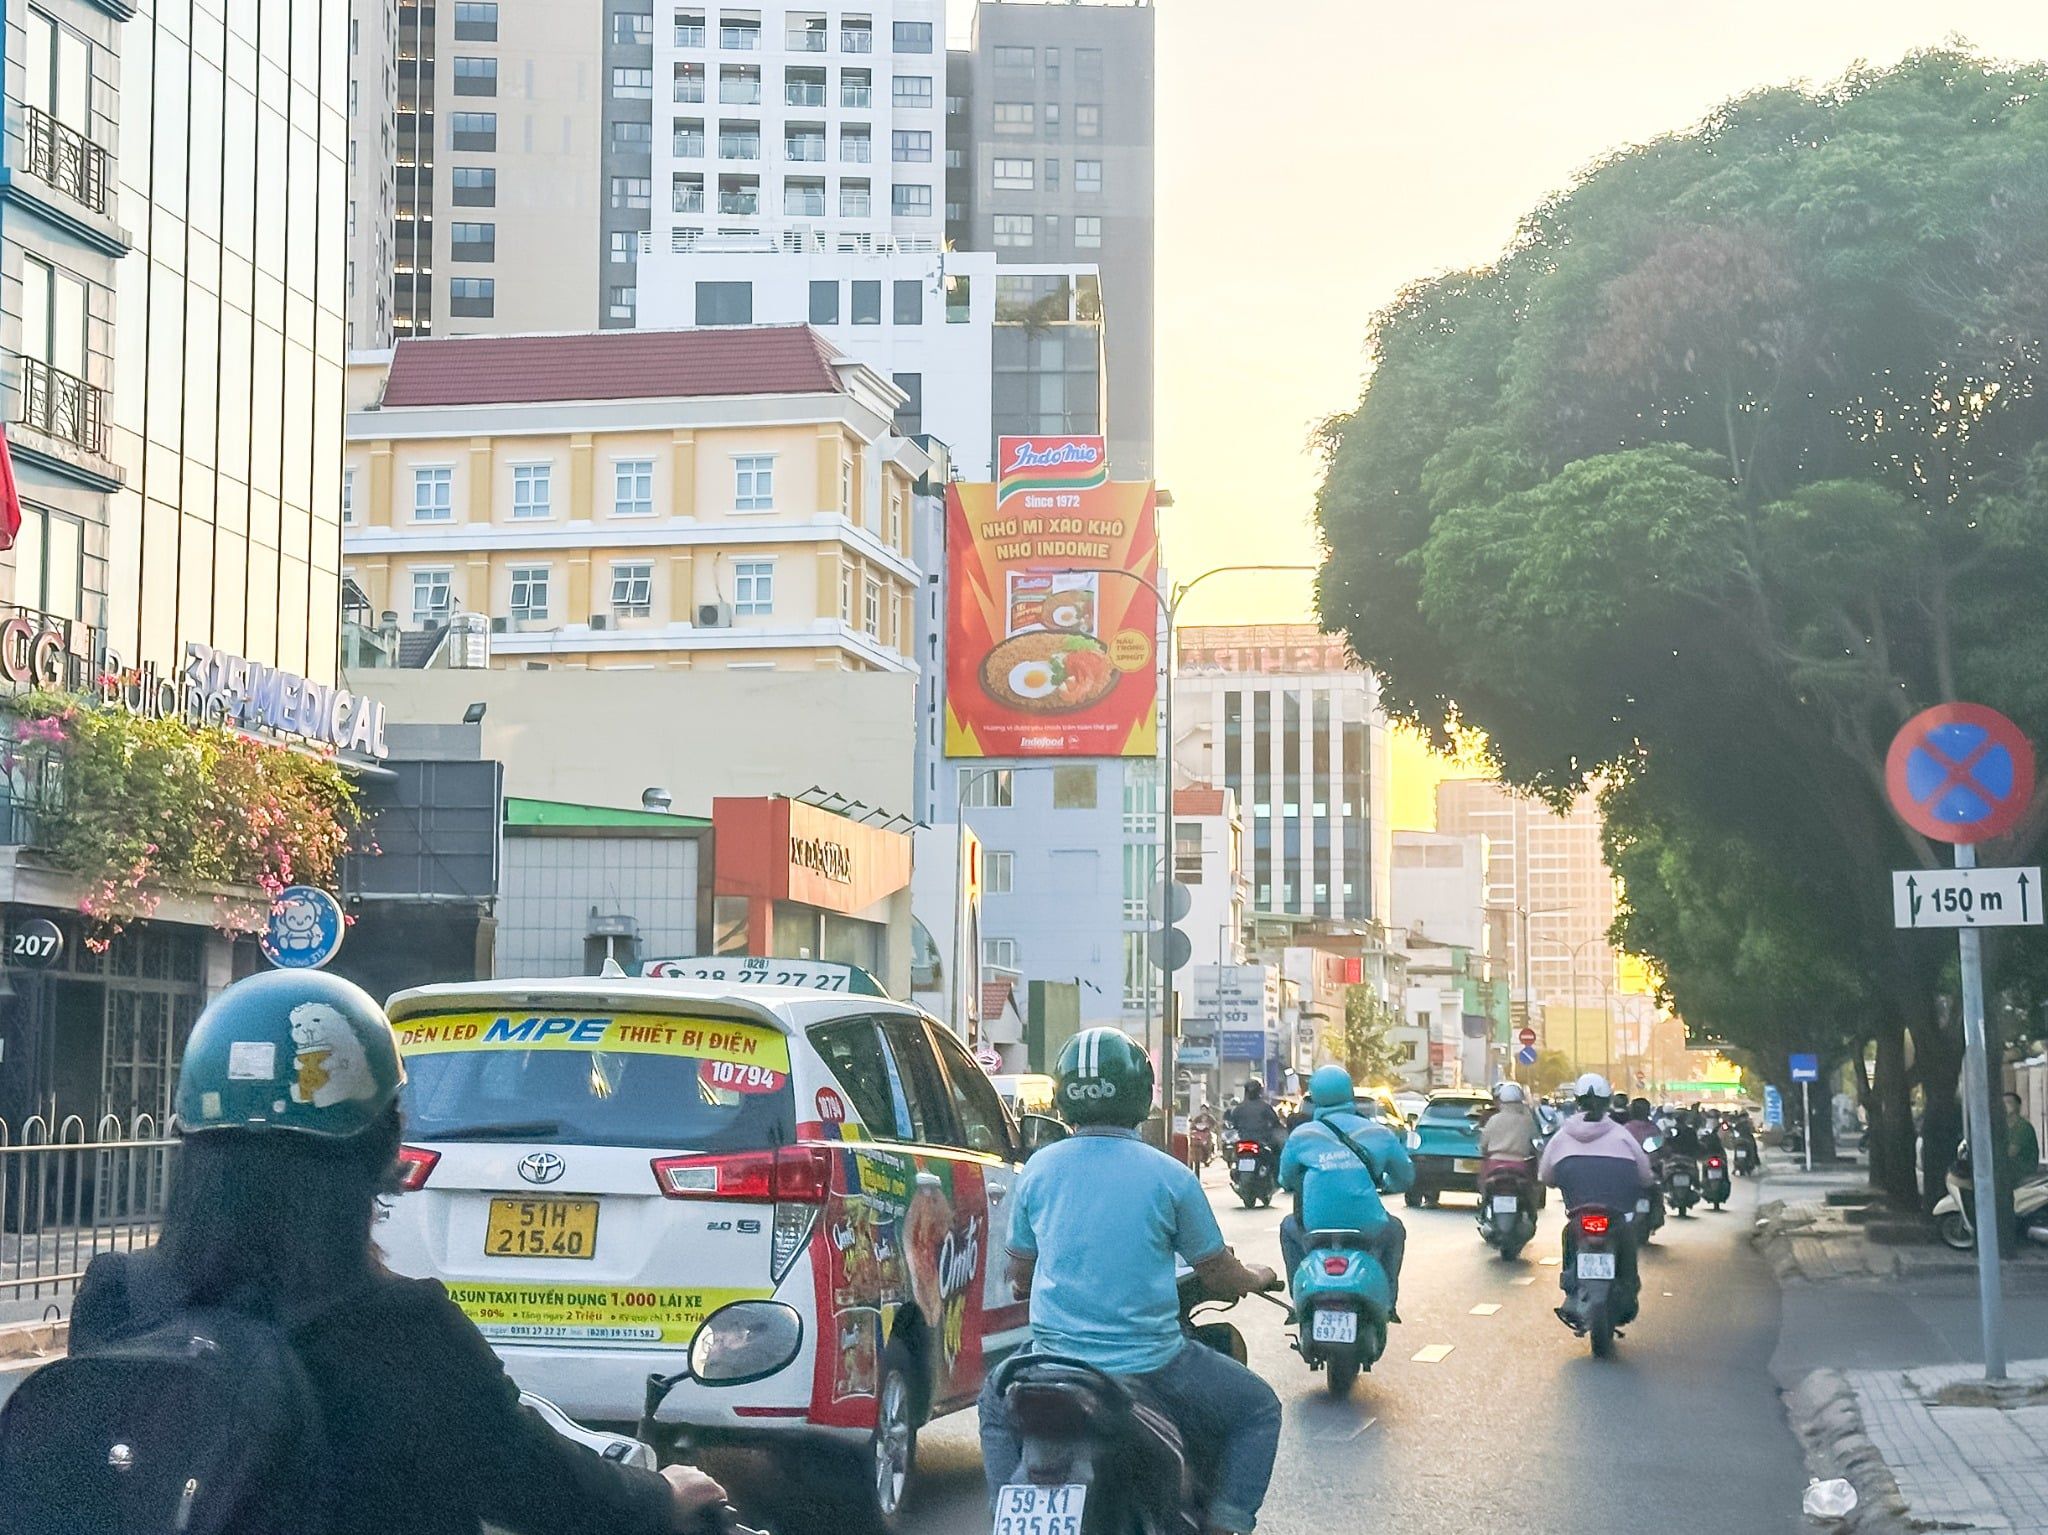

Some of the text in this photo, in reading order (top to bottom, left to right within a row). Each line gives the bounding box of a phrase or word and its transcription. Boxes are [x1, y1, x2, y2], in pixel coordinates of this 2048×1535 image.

[1025, 495, 1080, 508] Since 1972
[1022, 514, 1043, 534] MÌ
[1037, 541, 1109, 559] INDOMIE
[247, 662, 389, 759] MEDICAL
[1931, 887, 2002, 912] 150 m
[13, 934, 56, 957] 207
[743, 958, 769, 970] (028)
[738, 971, 769, 984] 27
[776, 972, 808, 987] 27
[814, 974, 846, 992] 27
[442, 1024, 478, 1041] LED
[482, 1016, 612, 1044] MPE
[619, 1022, 757, 1055] THIẾT BỊ ĐIỆN
[711, 1061, 774, 1088] 10794
[1067, 1079, 1116, 1100] Grab
[520, 1203, 567, 1227] 51H
[498, 1230, 583, 1255] 215.40
[450, 1290, 486, 1304] ASUN
[487, 1291, 517, 1304] TAXI
[520, 1289, 563, 1305] TUYỂN
[567, 1293, 607, 1309] DỤNG
[611, 1292, 656, 1307] 1.000
[685, 1295, 702, 1308] XE
[480, 1309, 504, 1318] 90%
[566, 1311, 573, 1320] 2
[666, 1313, 681, 1322] 1.5
